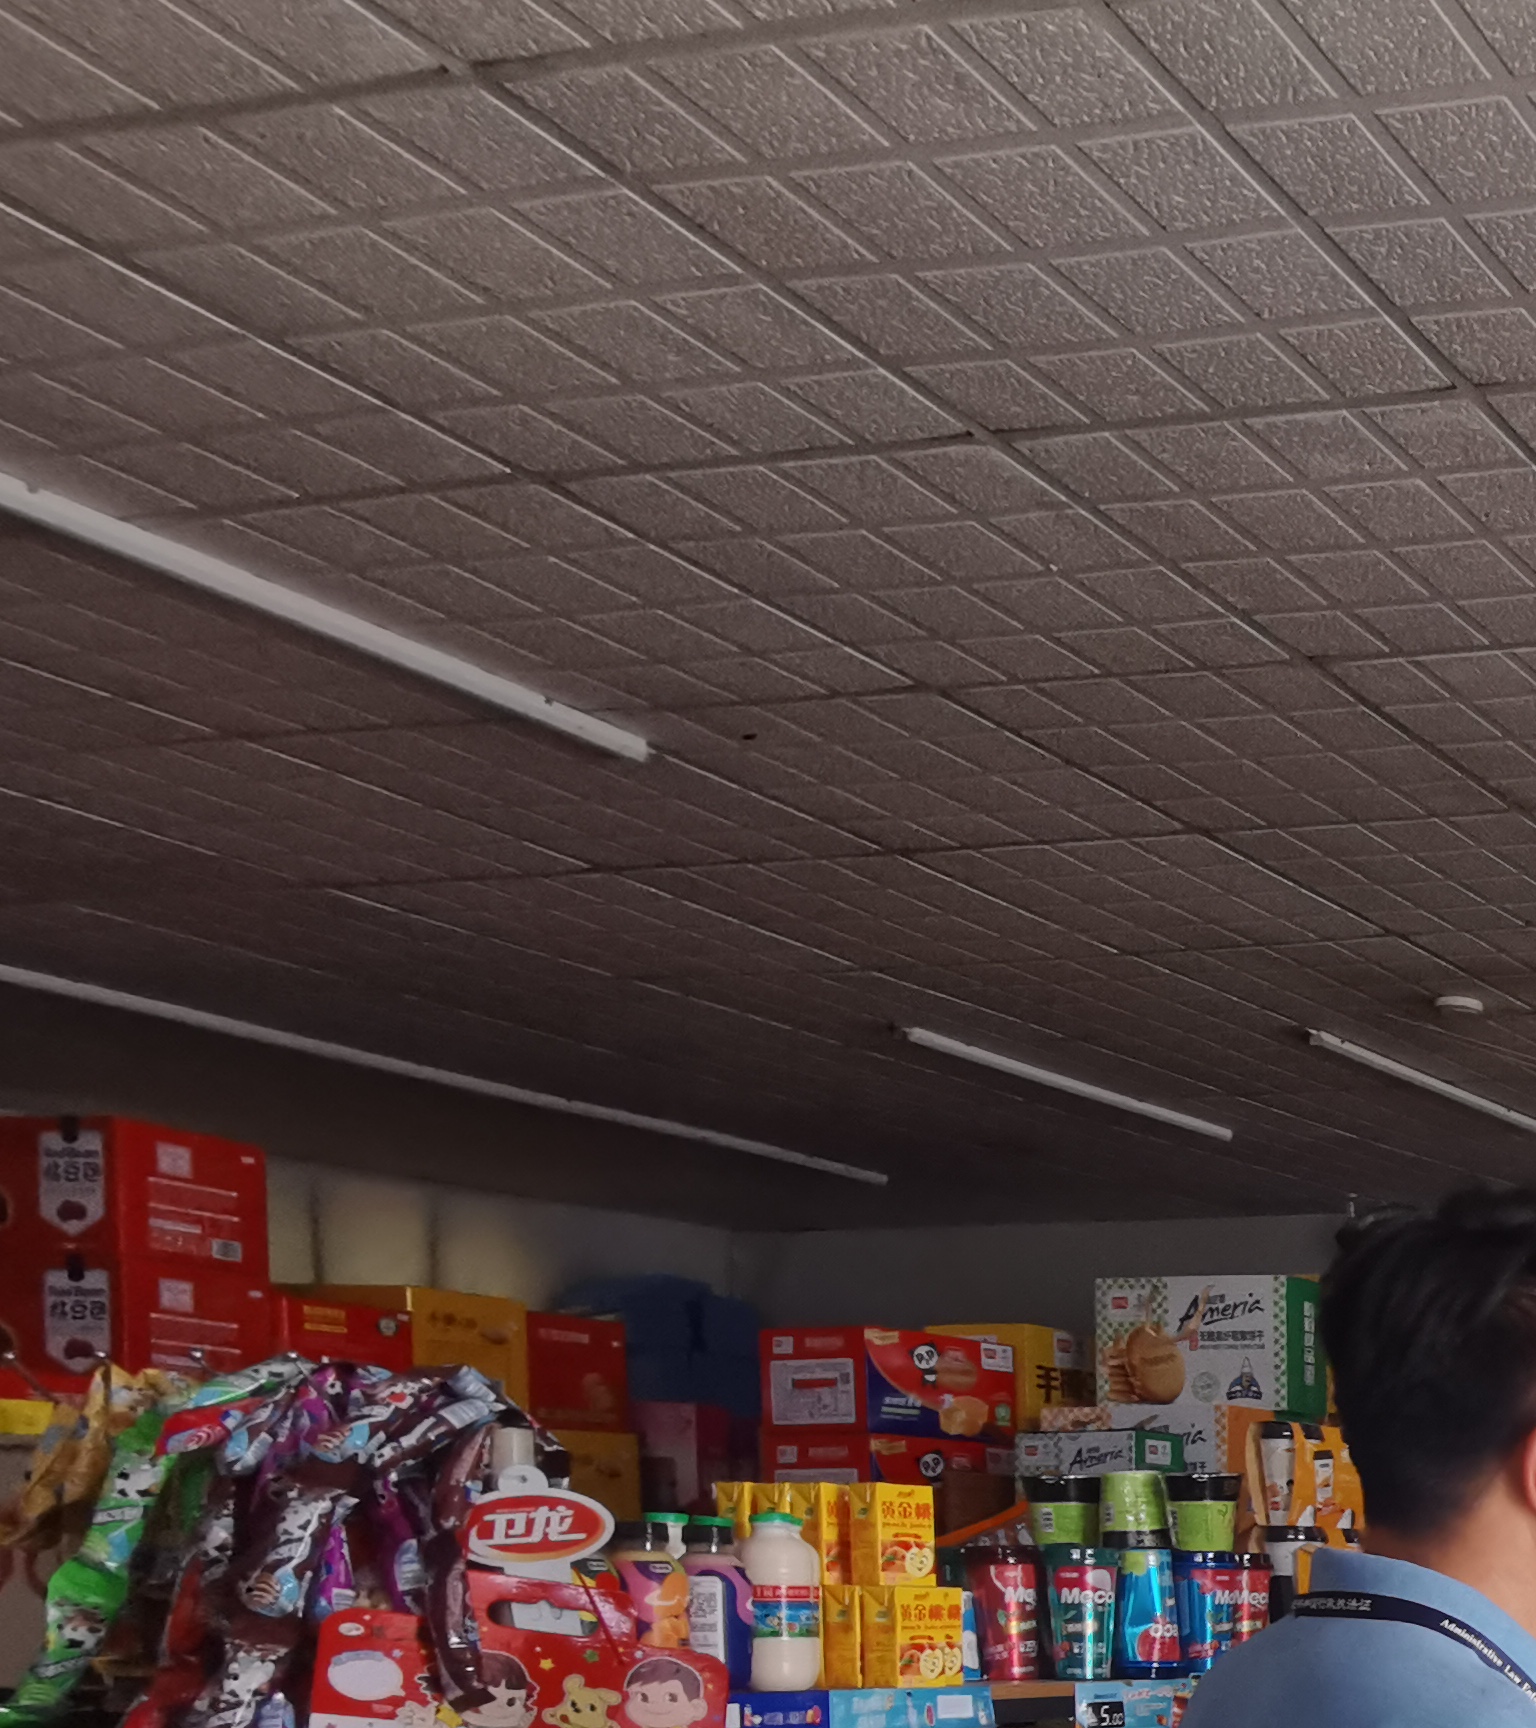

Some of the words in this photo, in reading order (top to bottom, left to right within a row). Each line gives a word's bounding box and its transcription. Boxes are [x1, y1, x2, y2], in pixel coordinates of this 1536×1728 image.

[482, 1505, 588, 1546] 卫龙
[1440, 1618, 1504, 1667] Administrative
[1504, 1665, 1522, 1684] Law
